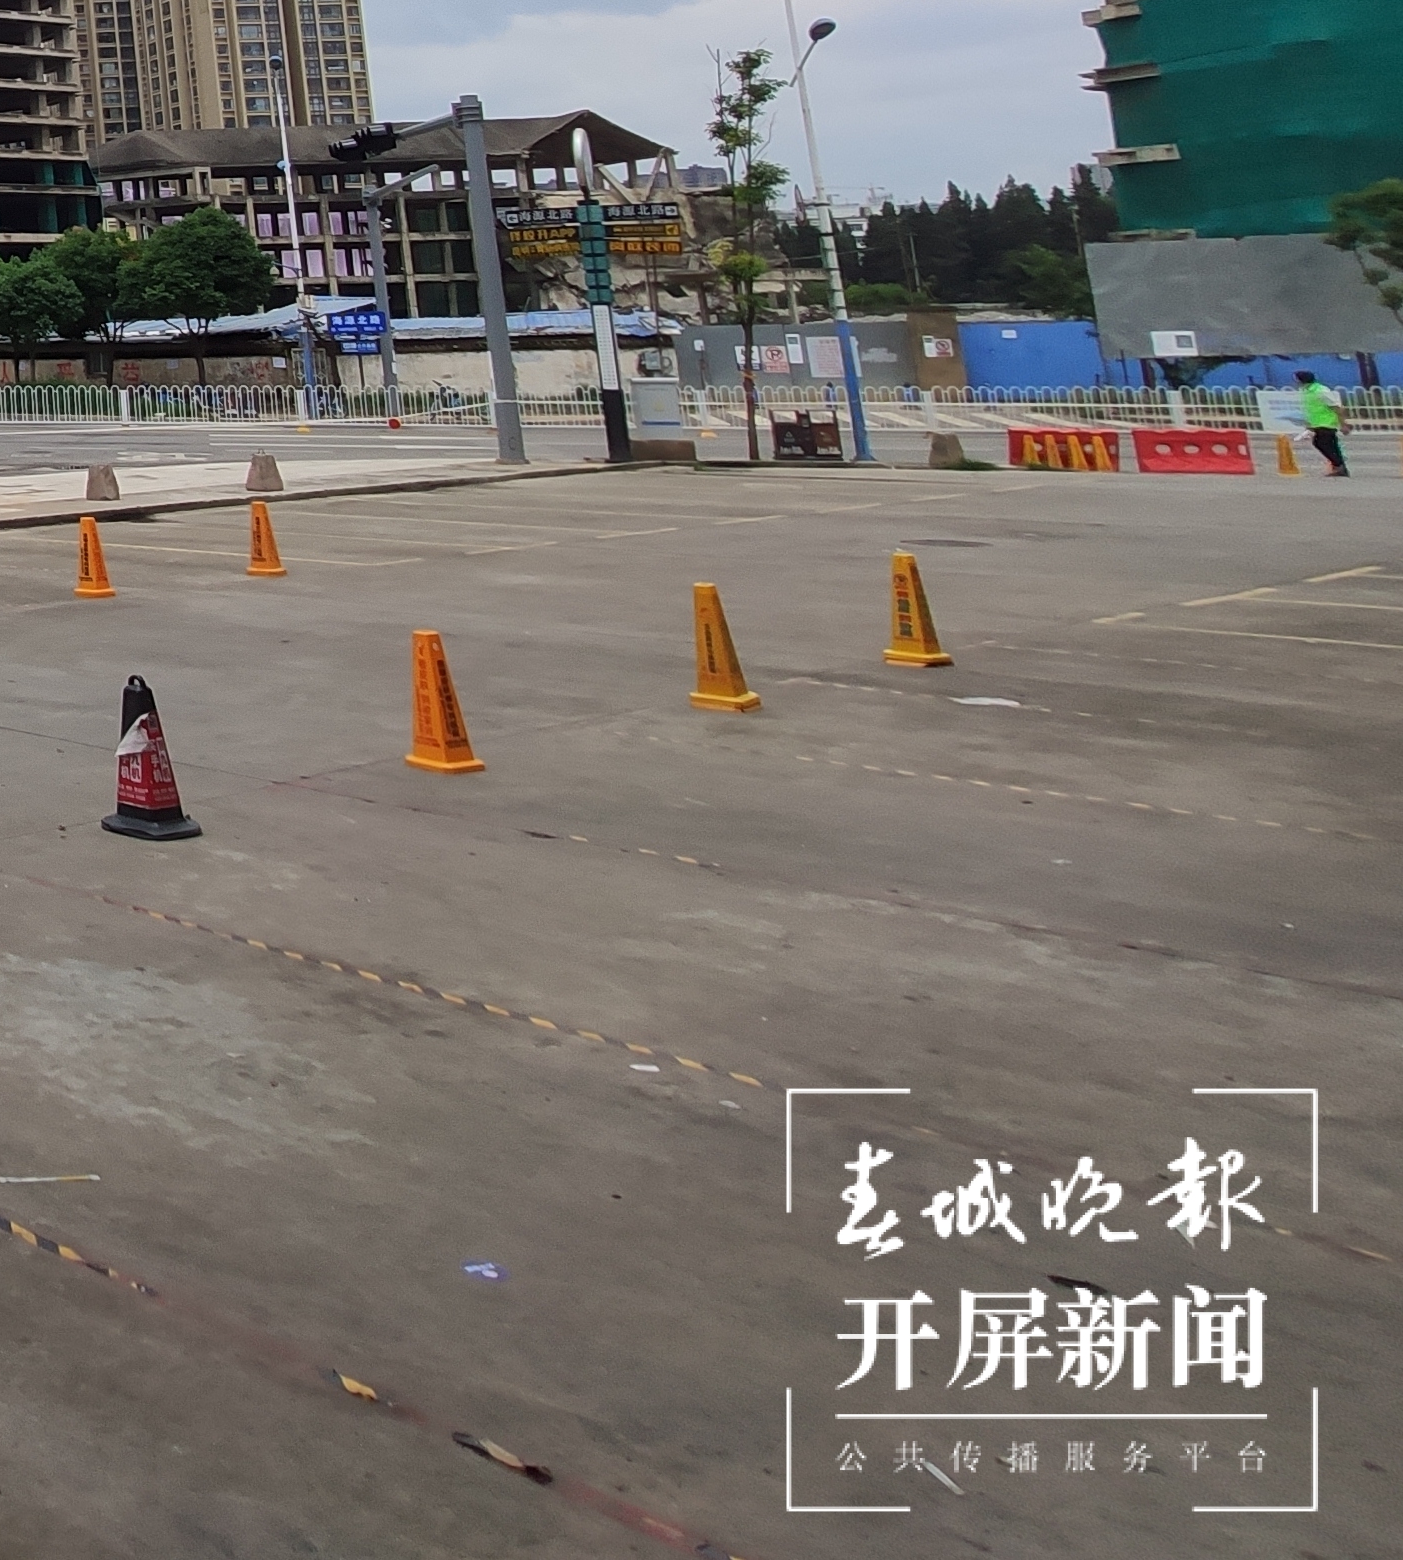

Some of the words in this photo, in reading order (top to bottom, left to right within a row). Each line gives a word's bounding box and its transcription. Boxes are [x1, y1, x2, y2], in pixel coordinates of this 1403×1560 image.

[519, 208, 573, 222] 海源北路
[607, 204, 665, 218] 海源北路
